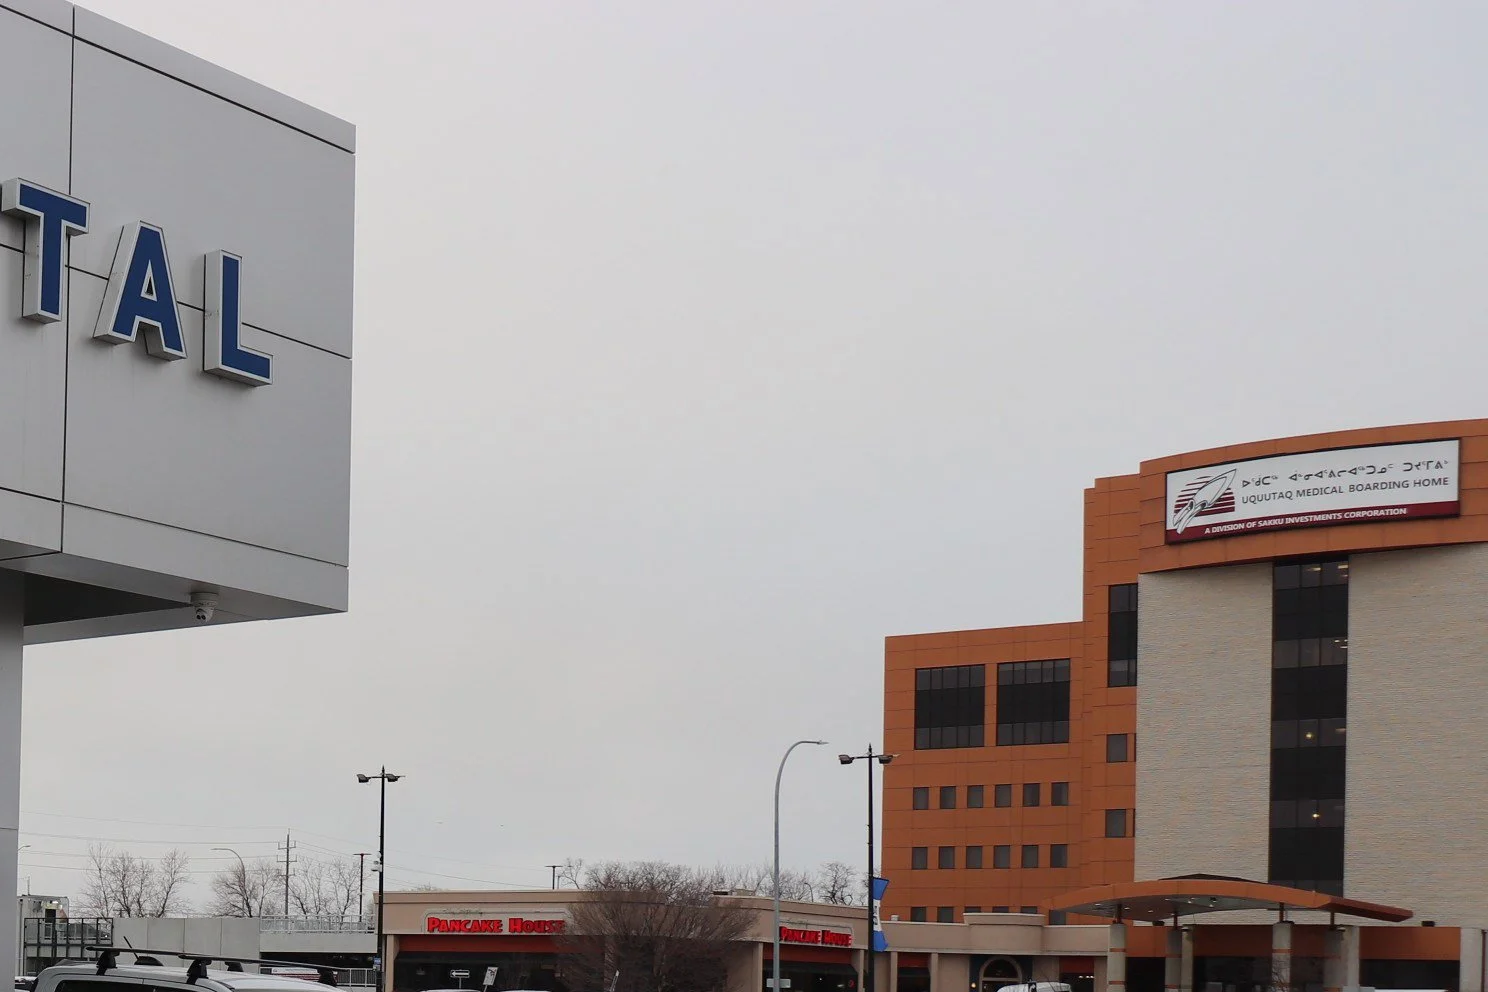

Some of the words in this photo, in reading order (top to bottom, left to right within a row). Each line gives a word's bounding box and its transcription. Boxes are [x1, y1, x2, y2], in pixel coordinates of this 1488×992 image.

[1242, 490, 1293, 504] UQUUTAQ
[1296, 485, 1343, 498] MEDICAL
[1349, 480, 1410, 493] BOARDING
[1413, 477, 1449, 488] HOME
[1211, 522, 1245, 533] DIVISION
[1246, 520, 1256, 529] OF
[1257, 517, 1284, 527] SAKKU
[1285, 512, 1342, 524] INVESTMENTS
[1344, 507, 1407, 519] CORPORATION
[427, 917, 503, 934] PANCAKE
[508, 917, 566, 934] HOUSE
